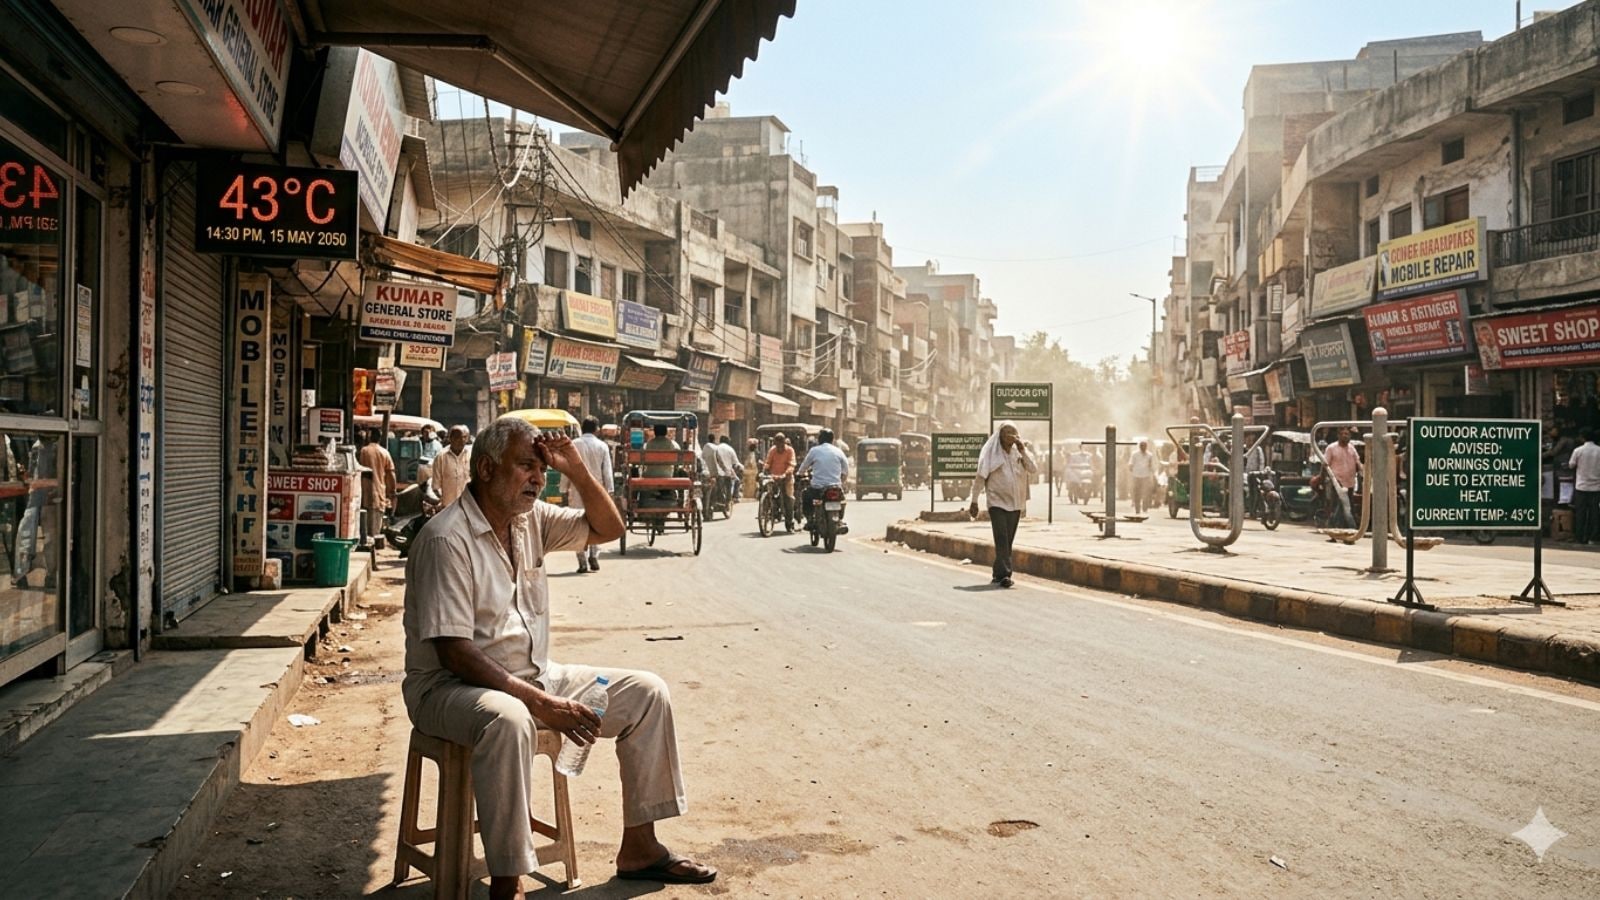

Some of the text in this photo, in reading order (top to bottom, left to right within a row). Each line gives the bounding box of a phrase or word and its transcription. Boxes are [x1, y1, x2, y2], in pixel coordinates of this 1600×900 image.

[219, 174, 335, 224] 43°C
[206, 226, 347, 246] 14:30 PM, 15 MAY 2050
[1434, 249, 1475, 275] REPAIR
[376, 285, 444, 307] KUMAR
[365, 302, 453, 322] GENERAL STORE
[1497, 317, 1599, 346] SWEET SHOP
[1420, 425, 1532, 440] OUTDOOR ACTIVITY
[1449, 442, 1503, 455] ADVISED:
[1428, 457, 1524, 471] MORNINGS ONLY
[308, 477, 339, 491] SHOP
[1425, 474, 1526, 487] DUE TO EXTREME
[1460, 490, 1492, 502] HEAT.
[1416, 508, 1471, 521] CURRENT
[1473, 508, 1508, 521] TEMP:
